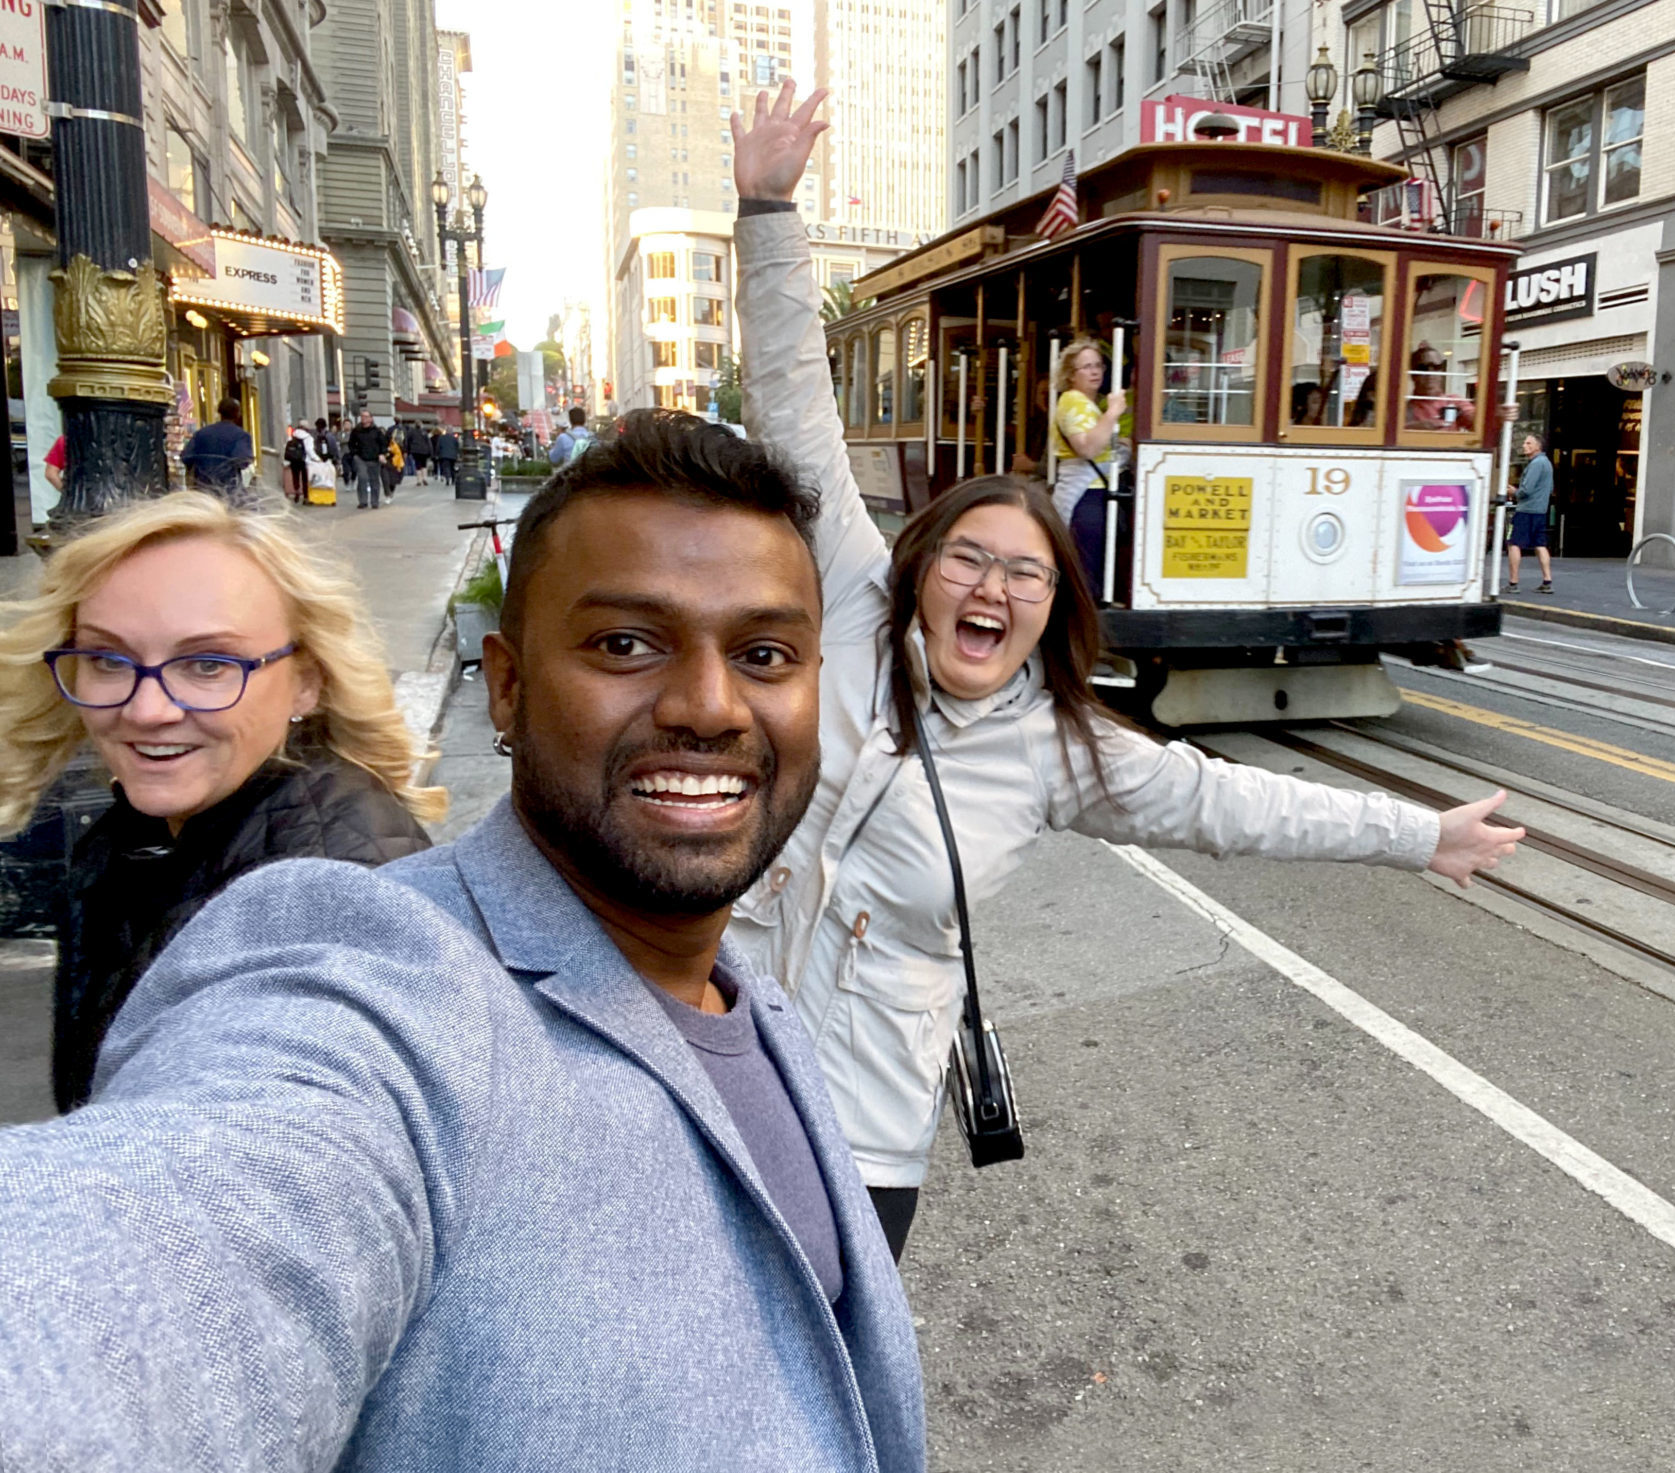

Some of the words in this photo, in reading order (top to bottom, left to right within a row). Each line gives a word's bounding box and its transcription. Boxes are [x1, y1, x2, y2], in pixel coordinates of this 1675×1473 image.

[839, 225, 898, 245] FIFTH
[225, 266, 278, 285] EXPRESS
[1504, 262, 1587, 311] LUSH
[1303, 467, 1351, 495] 19
[1170, 484, 1248, 497] POWELL
[1192, 498, 1230, 507] AND
[1168, 508, 1249, 520] MARKET
[1165, 535, 1187, 548] BAY
